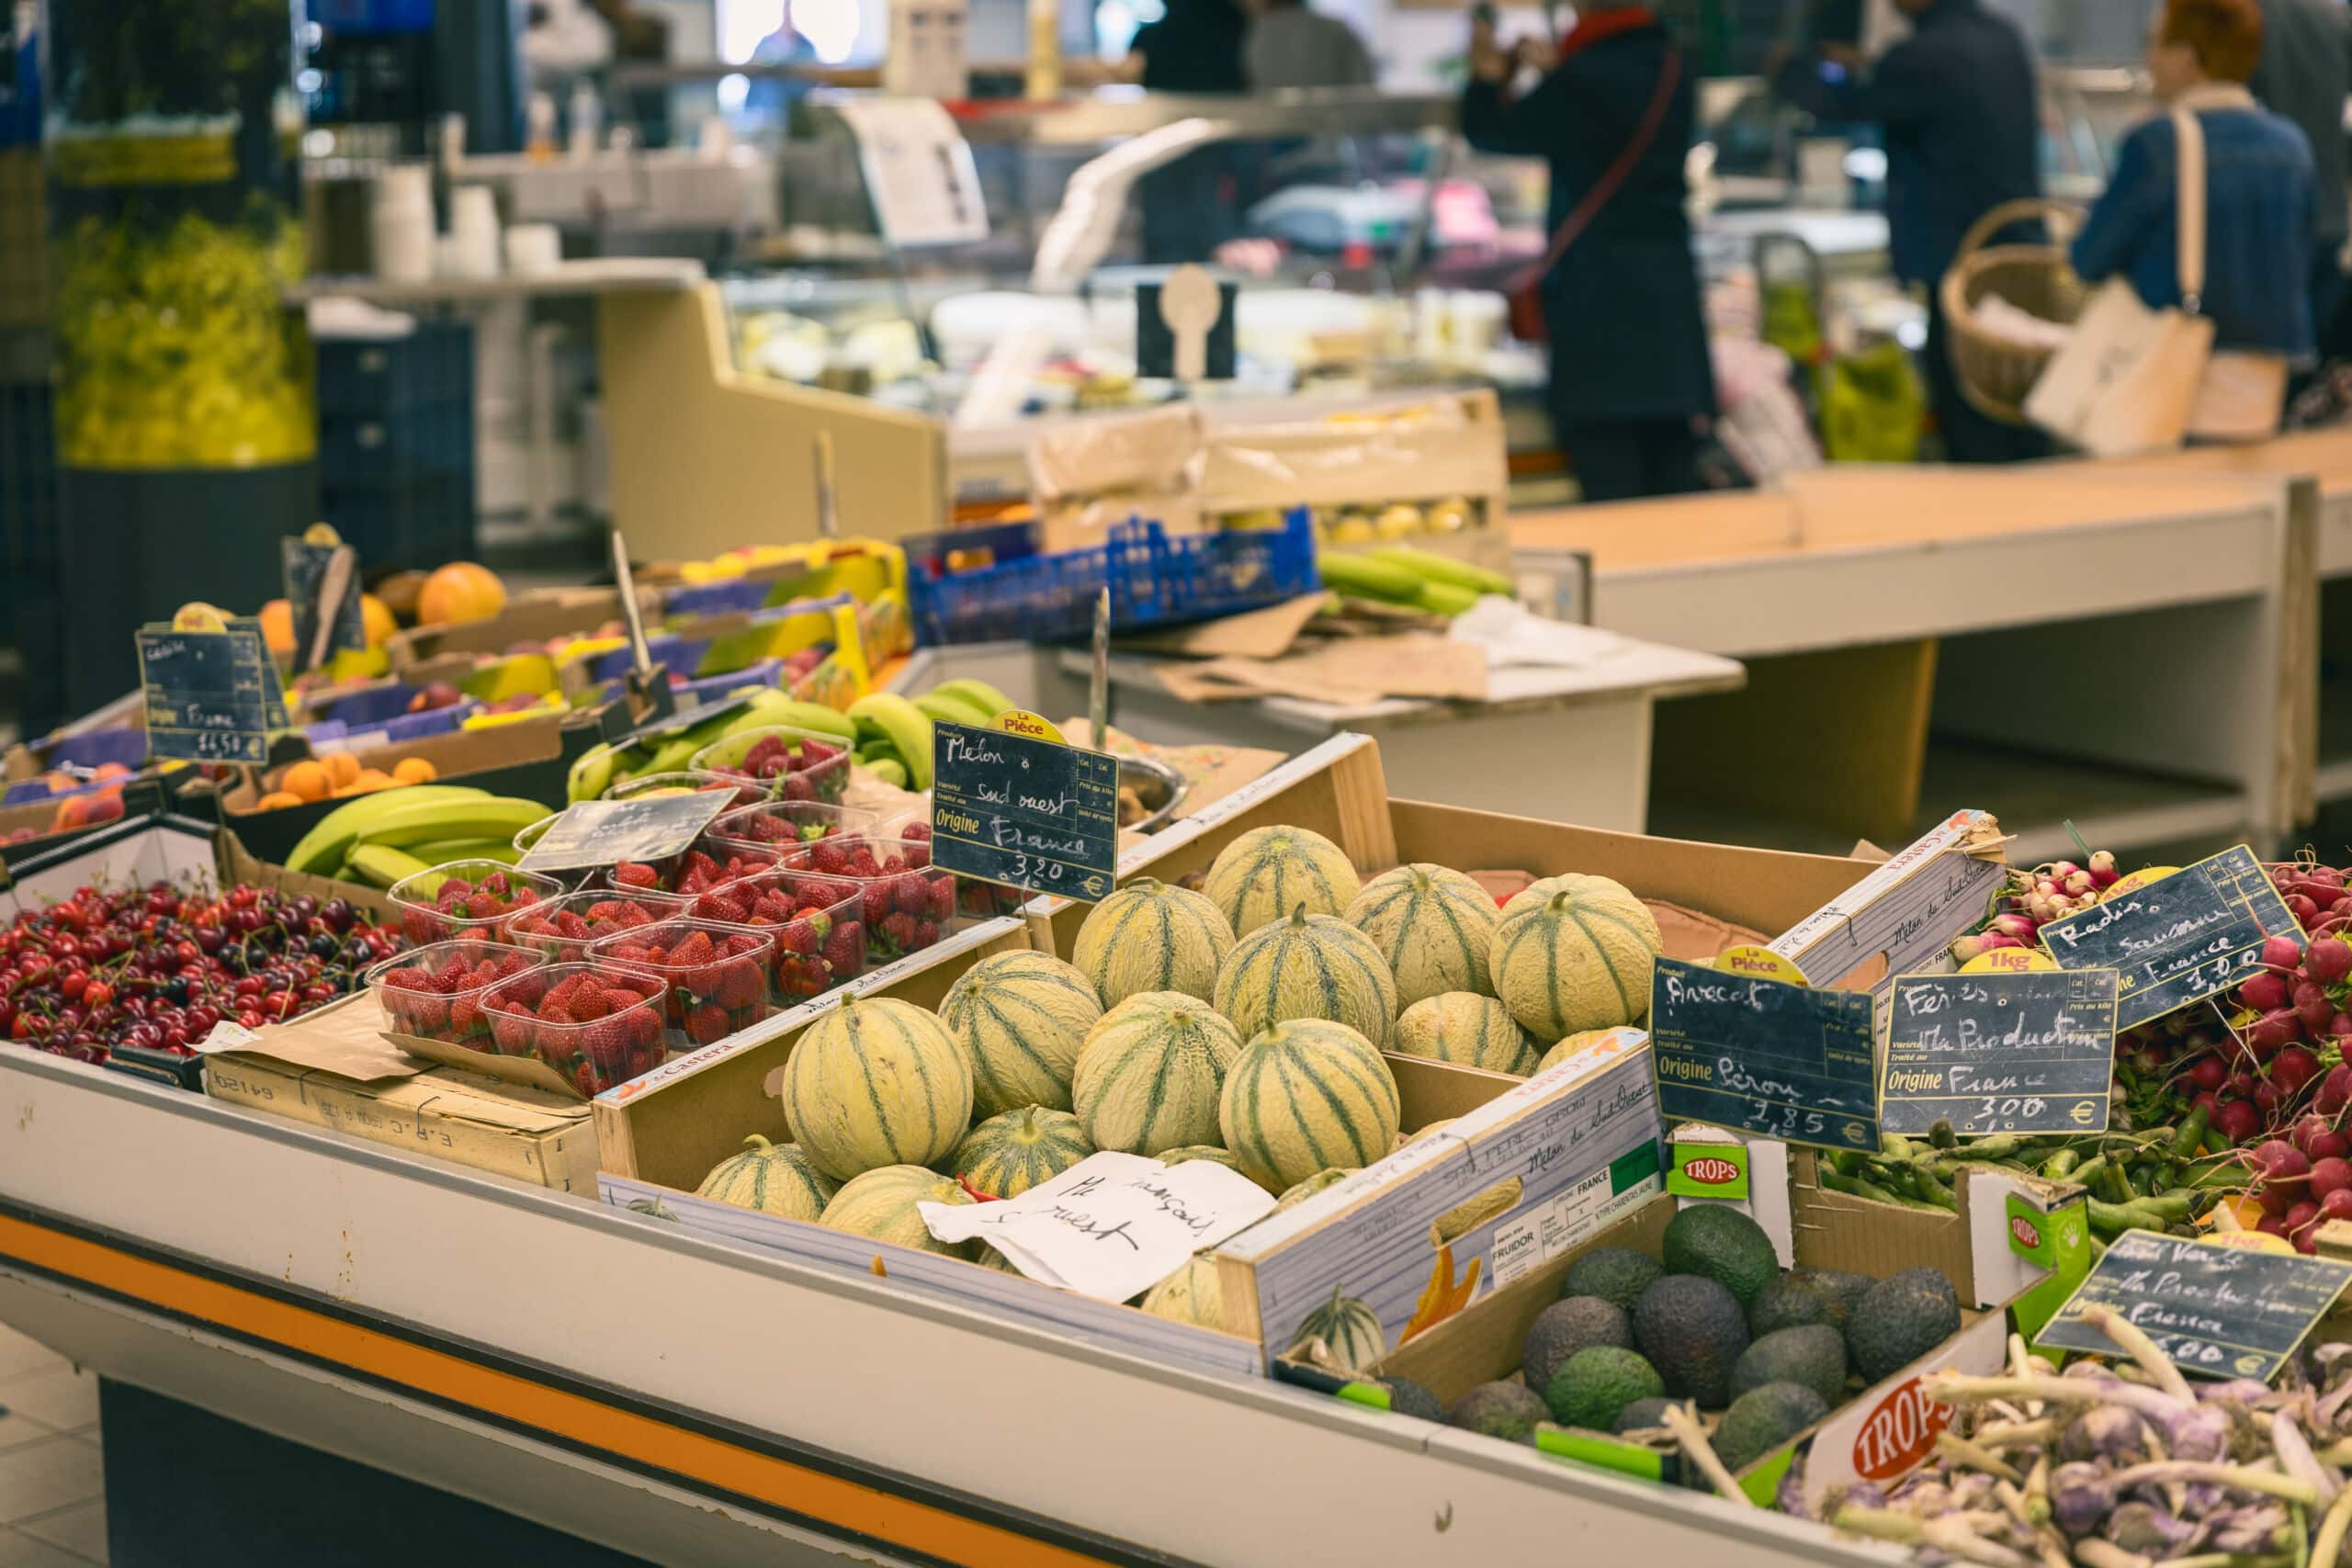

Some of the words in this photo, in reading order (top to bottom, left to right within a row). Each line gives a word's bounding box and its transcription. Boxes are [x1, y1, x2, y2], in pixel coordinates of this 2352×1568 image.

[1003, 718, 1045, 735] Pièce
[1017, 712, 1029, 721] La
[947, 736, 1005, 762] Melon
[977, 780, 1012, 805] Sud
[1019, 791, 1080, 816] ouest
[935, 807, 980, 834] Origine
[1080, 874, 1104, 897] €
[1731, 956, 1779, 973] Pièce
[1746, 948, 1759, 958] La
[1988, 952, 2031, 972] 1kg
[1660, 1055, 1713, 1081] Origine
[1888, 1069, 1942, 1093] Origine
[2069, 1100, 2096, 1125] €
[1841, 1122, 1867, 1145] €
[1684, 1158, 1739, 1180] TROPS
[1577, 1169, 1608, 1195] FRANCE
[1492, 1231, 1534, 1260] FRUIDOR
